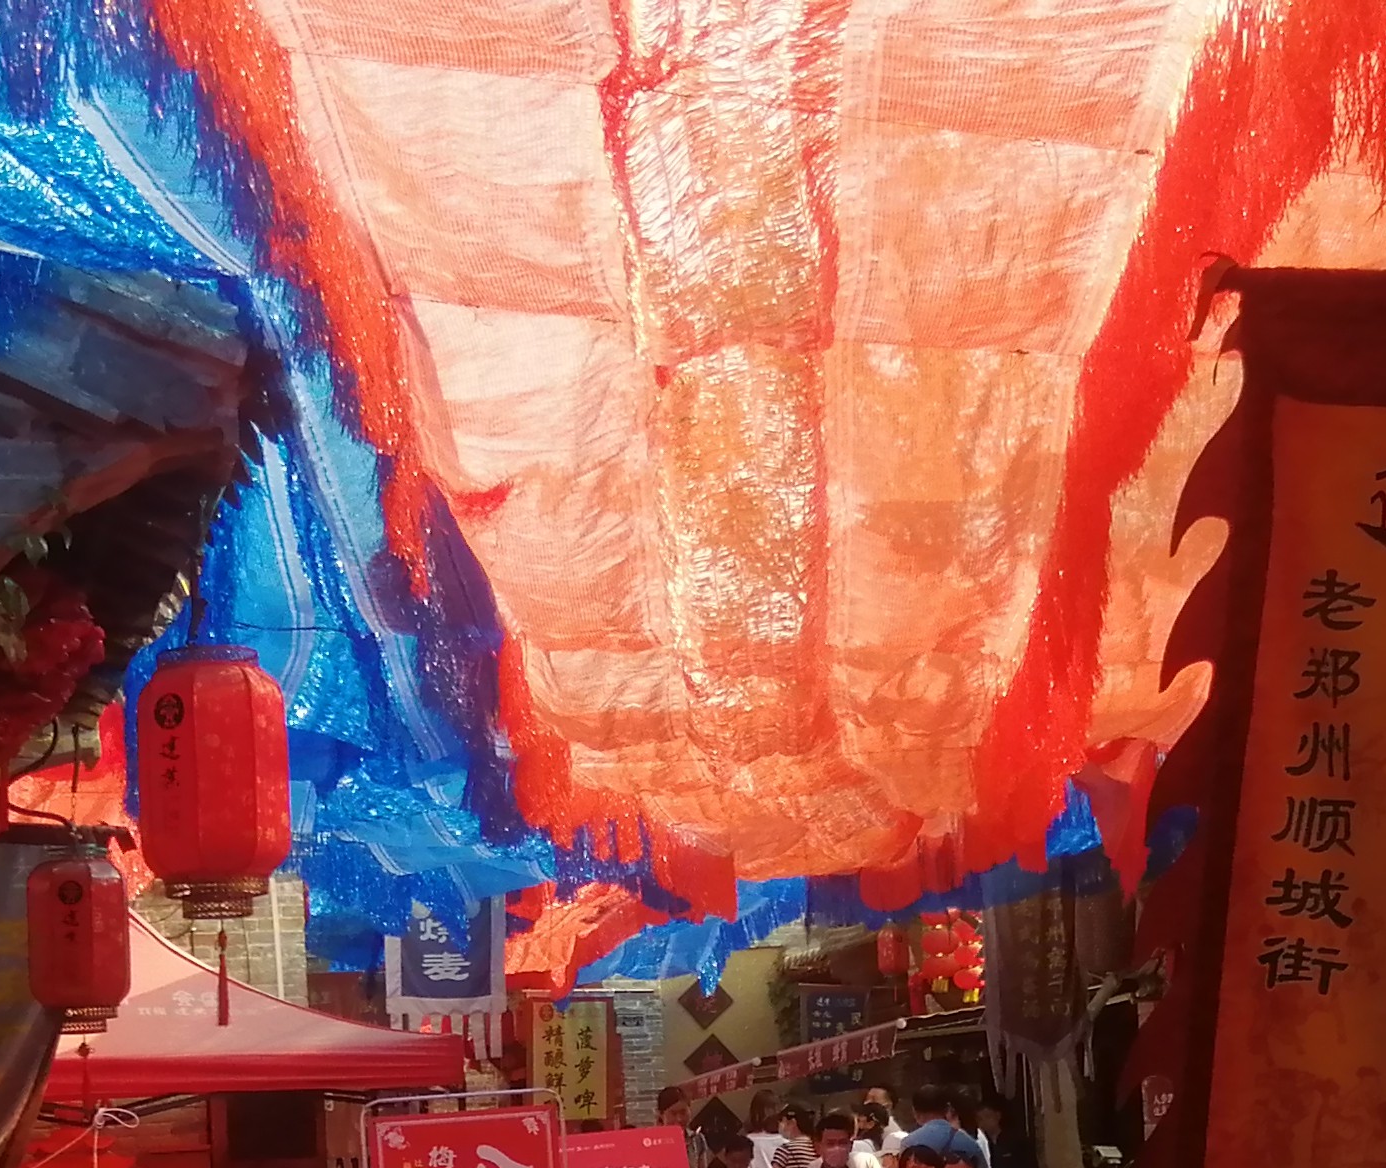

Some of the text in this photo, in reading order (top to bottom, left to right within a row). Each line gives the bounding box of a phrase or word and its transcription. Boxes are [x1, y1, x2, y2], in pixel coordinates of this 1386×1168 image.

[1258, 569, 1375, 995] 老郑州顺城街
